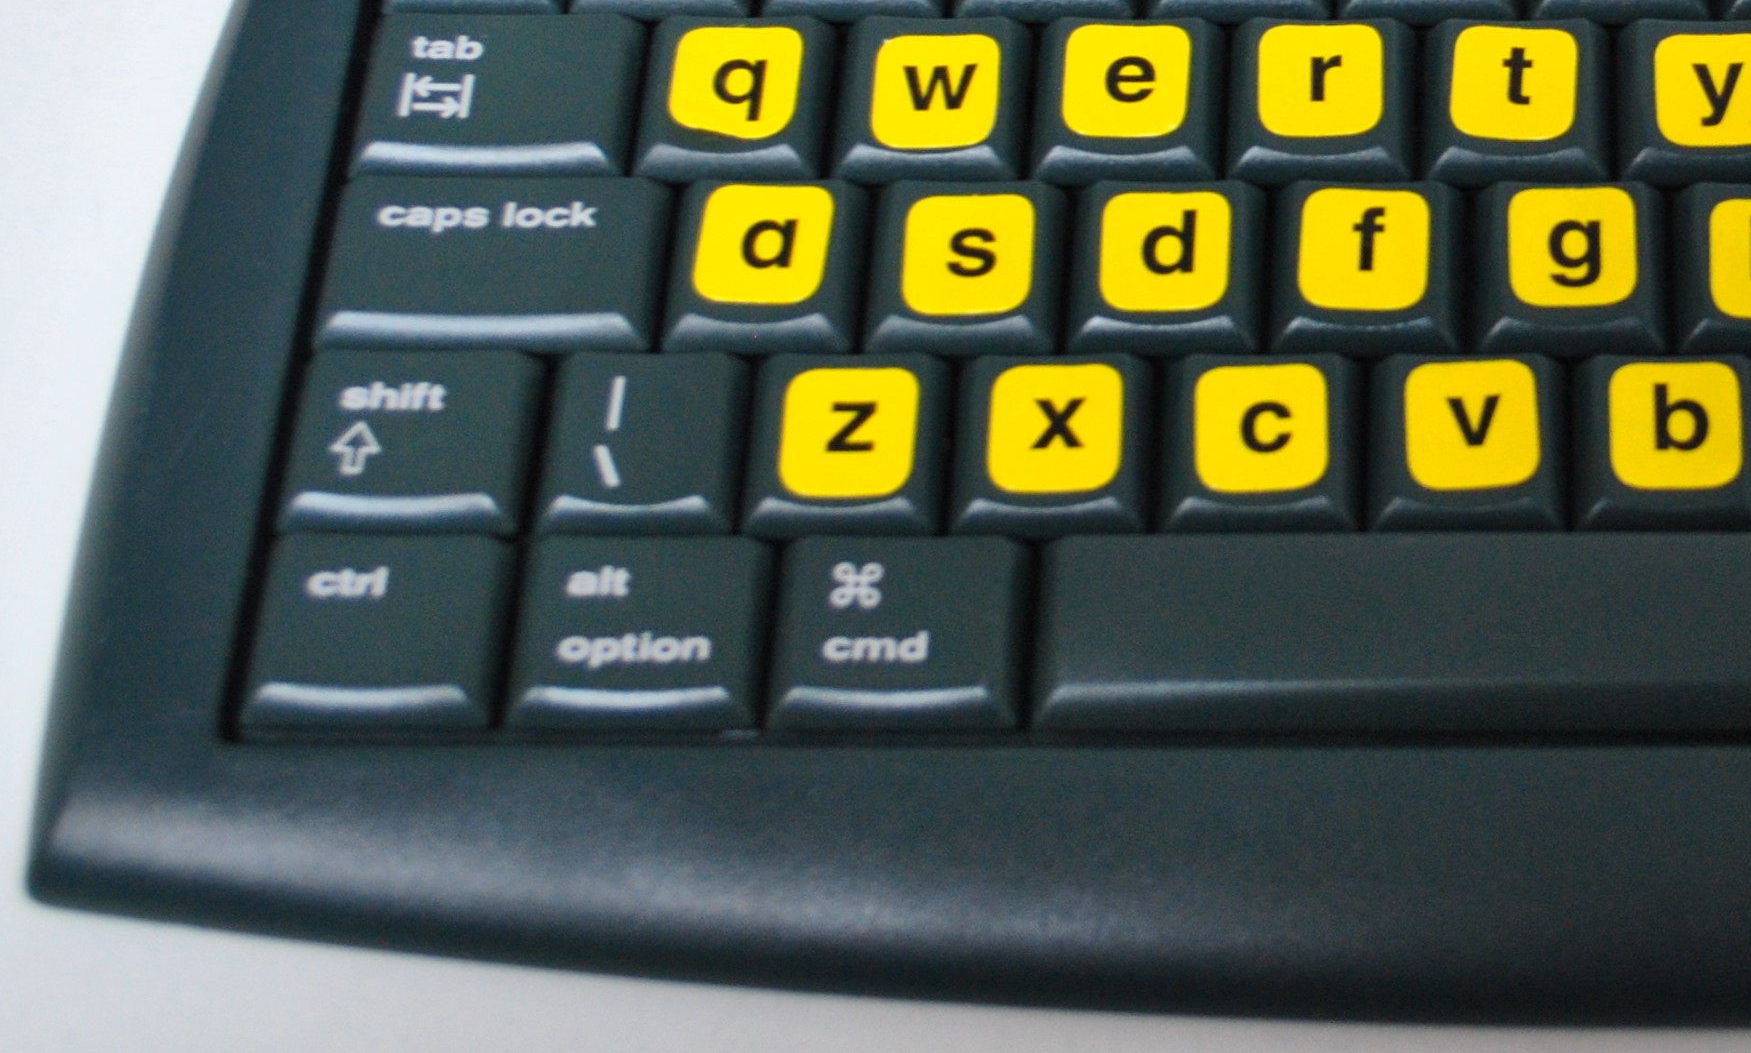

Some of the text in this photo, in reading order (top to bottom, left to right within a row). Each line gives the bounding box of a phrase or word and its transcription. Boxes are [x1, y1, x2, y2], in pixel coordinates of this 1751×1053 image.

[412, 35, 484, 61] tab
[712, 58, 767, 122] q
[903, 63, 977, 112] w
[1105, 55, 1156, 104] e
[1310, 54, 1342, 102] r
[1502, 46, 1533, 106] t
[1692, 62, 1744, 127] y
[377, 201, 596, 234] caps lock
[1141, 209, 1197, 276] d
[1352, 206, 1386, 272] f
[741, 219, 798, 270] a
[947, 227, 997, 278] s
[1548, 219, 1602, 289] g
[340, 381, 446, 411] shift
[1447, 394, 1500, 447] v
[1653, 383, 1710, 452] b
[825, 401, 877, 453] z
[1032, 398, 1084, 450] x
[1240, 401, 1292, 454] c
[307, 566, 389, 597] ctrl
[566, 565, 630, 597] alt
[556, 631, 711, 669] option
[822, 631, 929, 662] cmd
